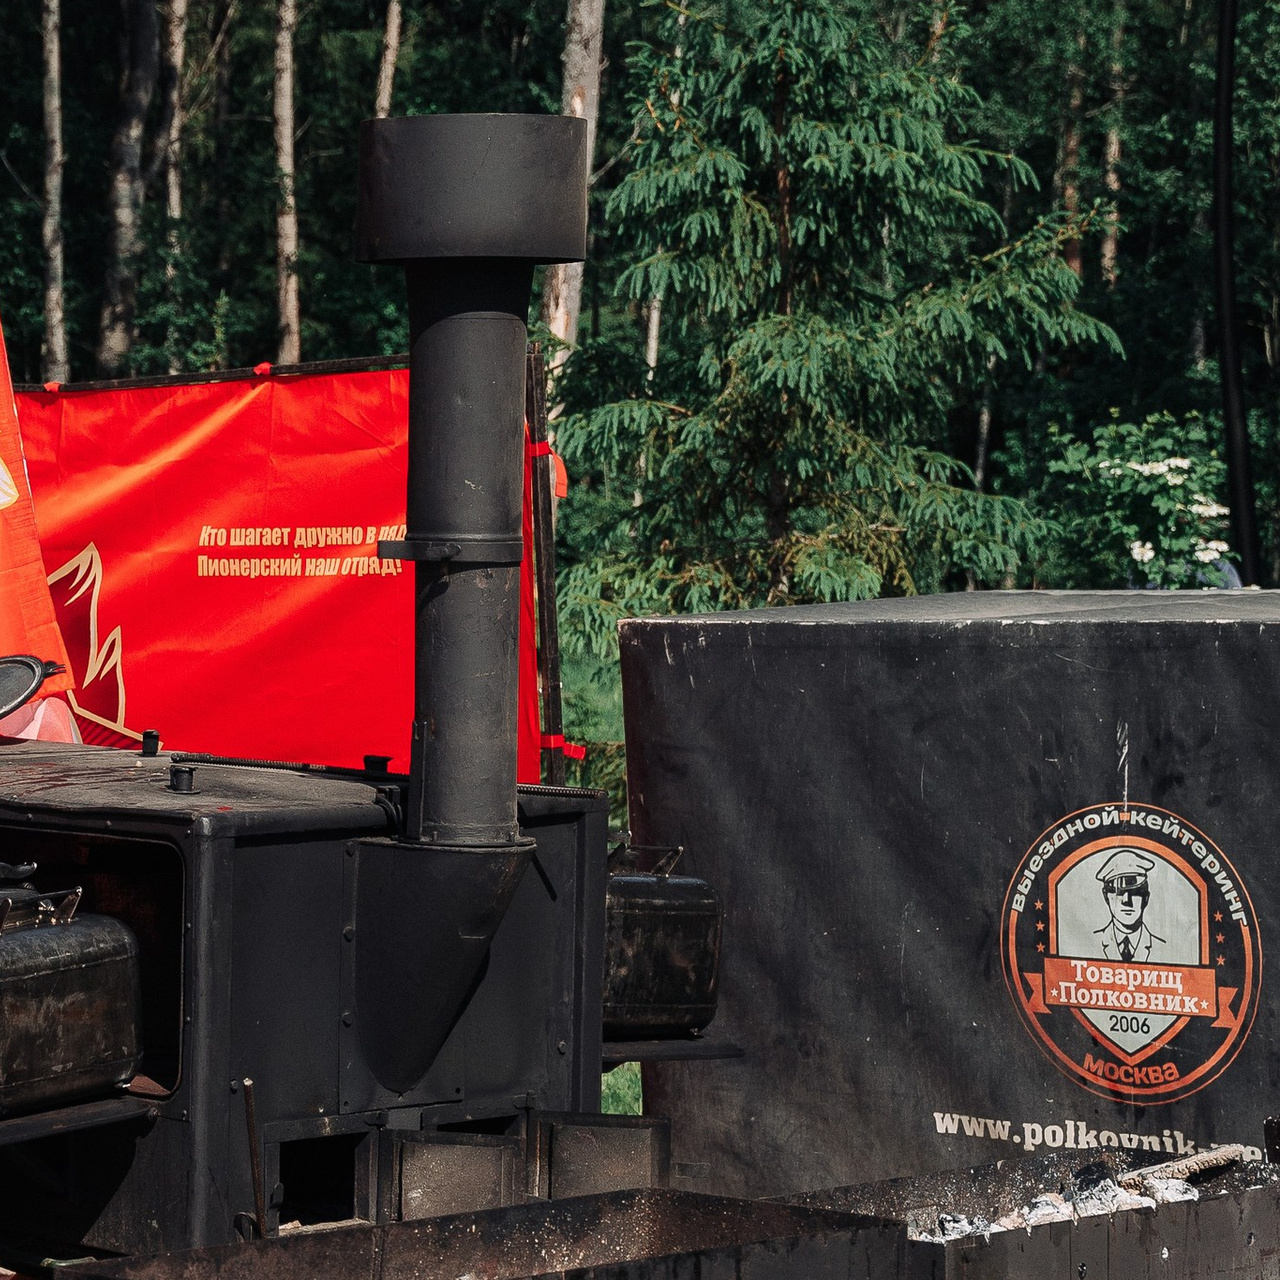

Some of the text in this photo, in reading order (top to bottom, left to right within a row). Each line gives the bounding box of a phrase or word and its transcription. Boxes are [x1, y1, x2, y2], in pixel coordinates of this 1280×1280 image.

[198, 525, 227, 547] Кто
[229, 527, 291, 547] шагает
[293, 526, 364, 549] дружно
[365, 526, 378, 546] в
[197, 553, 403, 579] Пионерский наш отряд!
[1070, 960, 1183, 991] Товарищ
[1058, 980, 1200, 1013] Полковник
[1109, 1014, 1151, 1035] 2006
